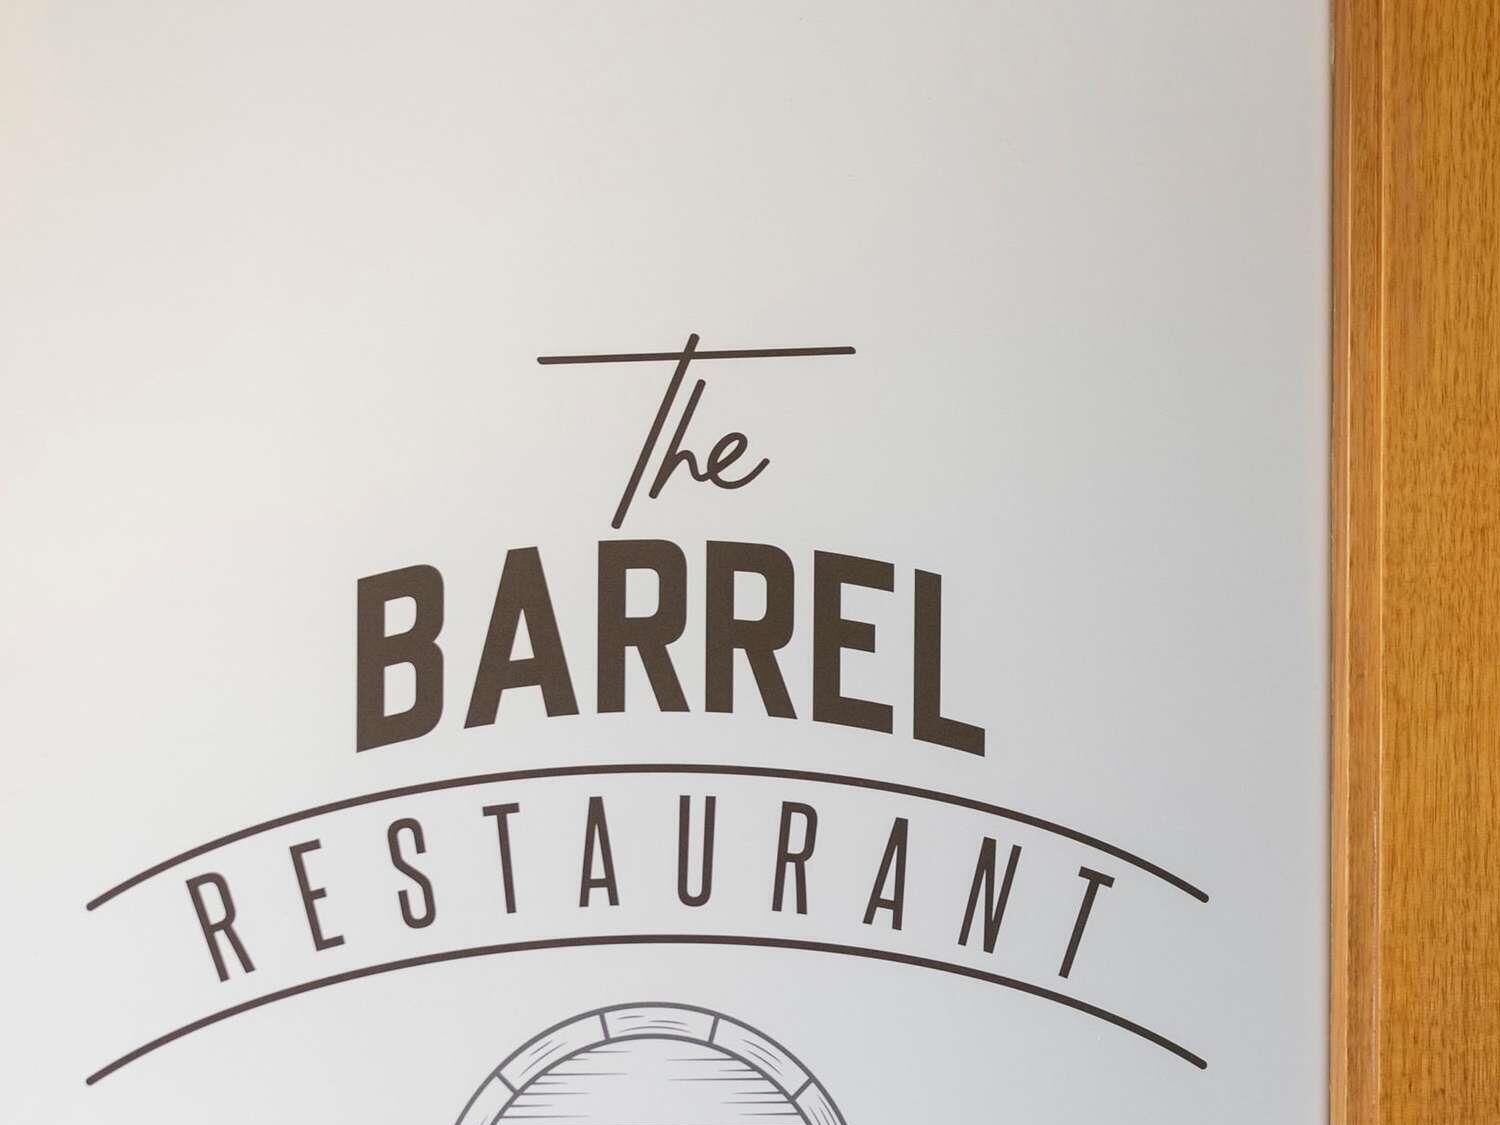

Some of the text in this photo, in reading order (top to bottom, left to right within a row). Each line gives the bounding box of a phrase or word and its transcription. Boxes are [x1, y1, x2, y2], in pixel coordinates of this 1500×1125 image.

[536, 332, 857, 530] The
[355, 538, 987, 759] BARREL
[184, 793, 1117, 984] RESTAURANT
